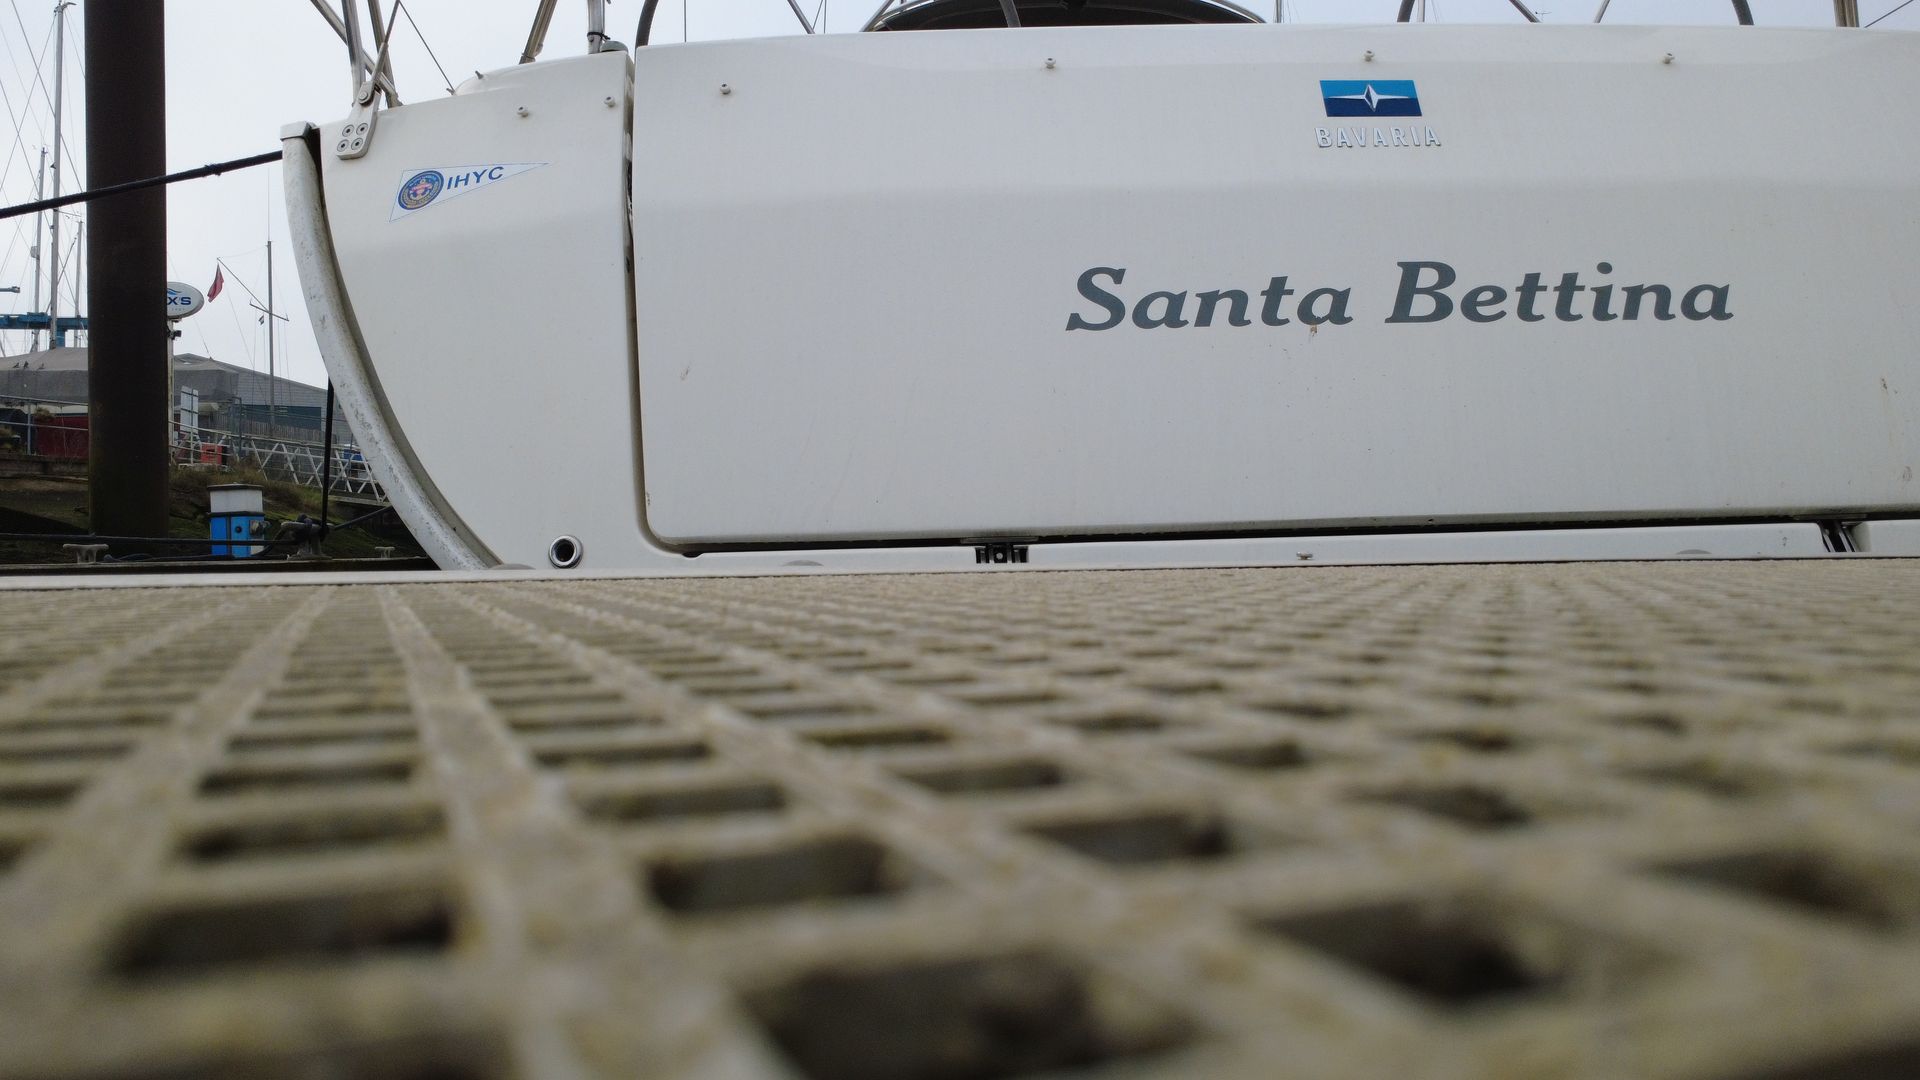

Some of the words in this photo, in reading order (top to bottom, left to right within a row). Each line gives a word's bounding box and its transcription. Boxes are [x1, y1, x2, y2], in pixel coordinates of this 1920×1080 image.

[1315, 125, 1442, 148] BAVARIA
[447, 166, 505, 190] IHYC
[1065, 266, 1354, 332] Santa
[1384, 260, 1735, 324] Bettina
